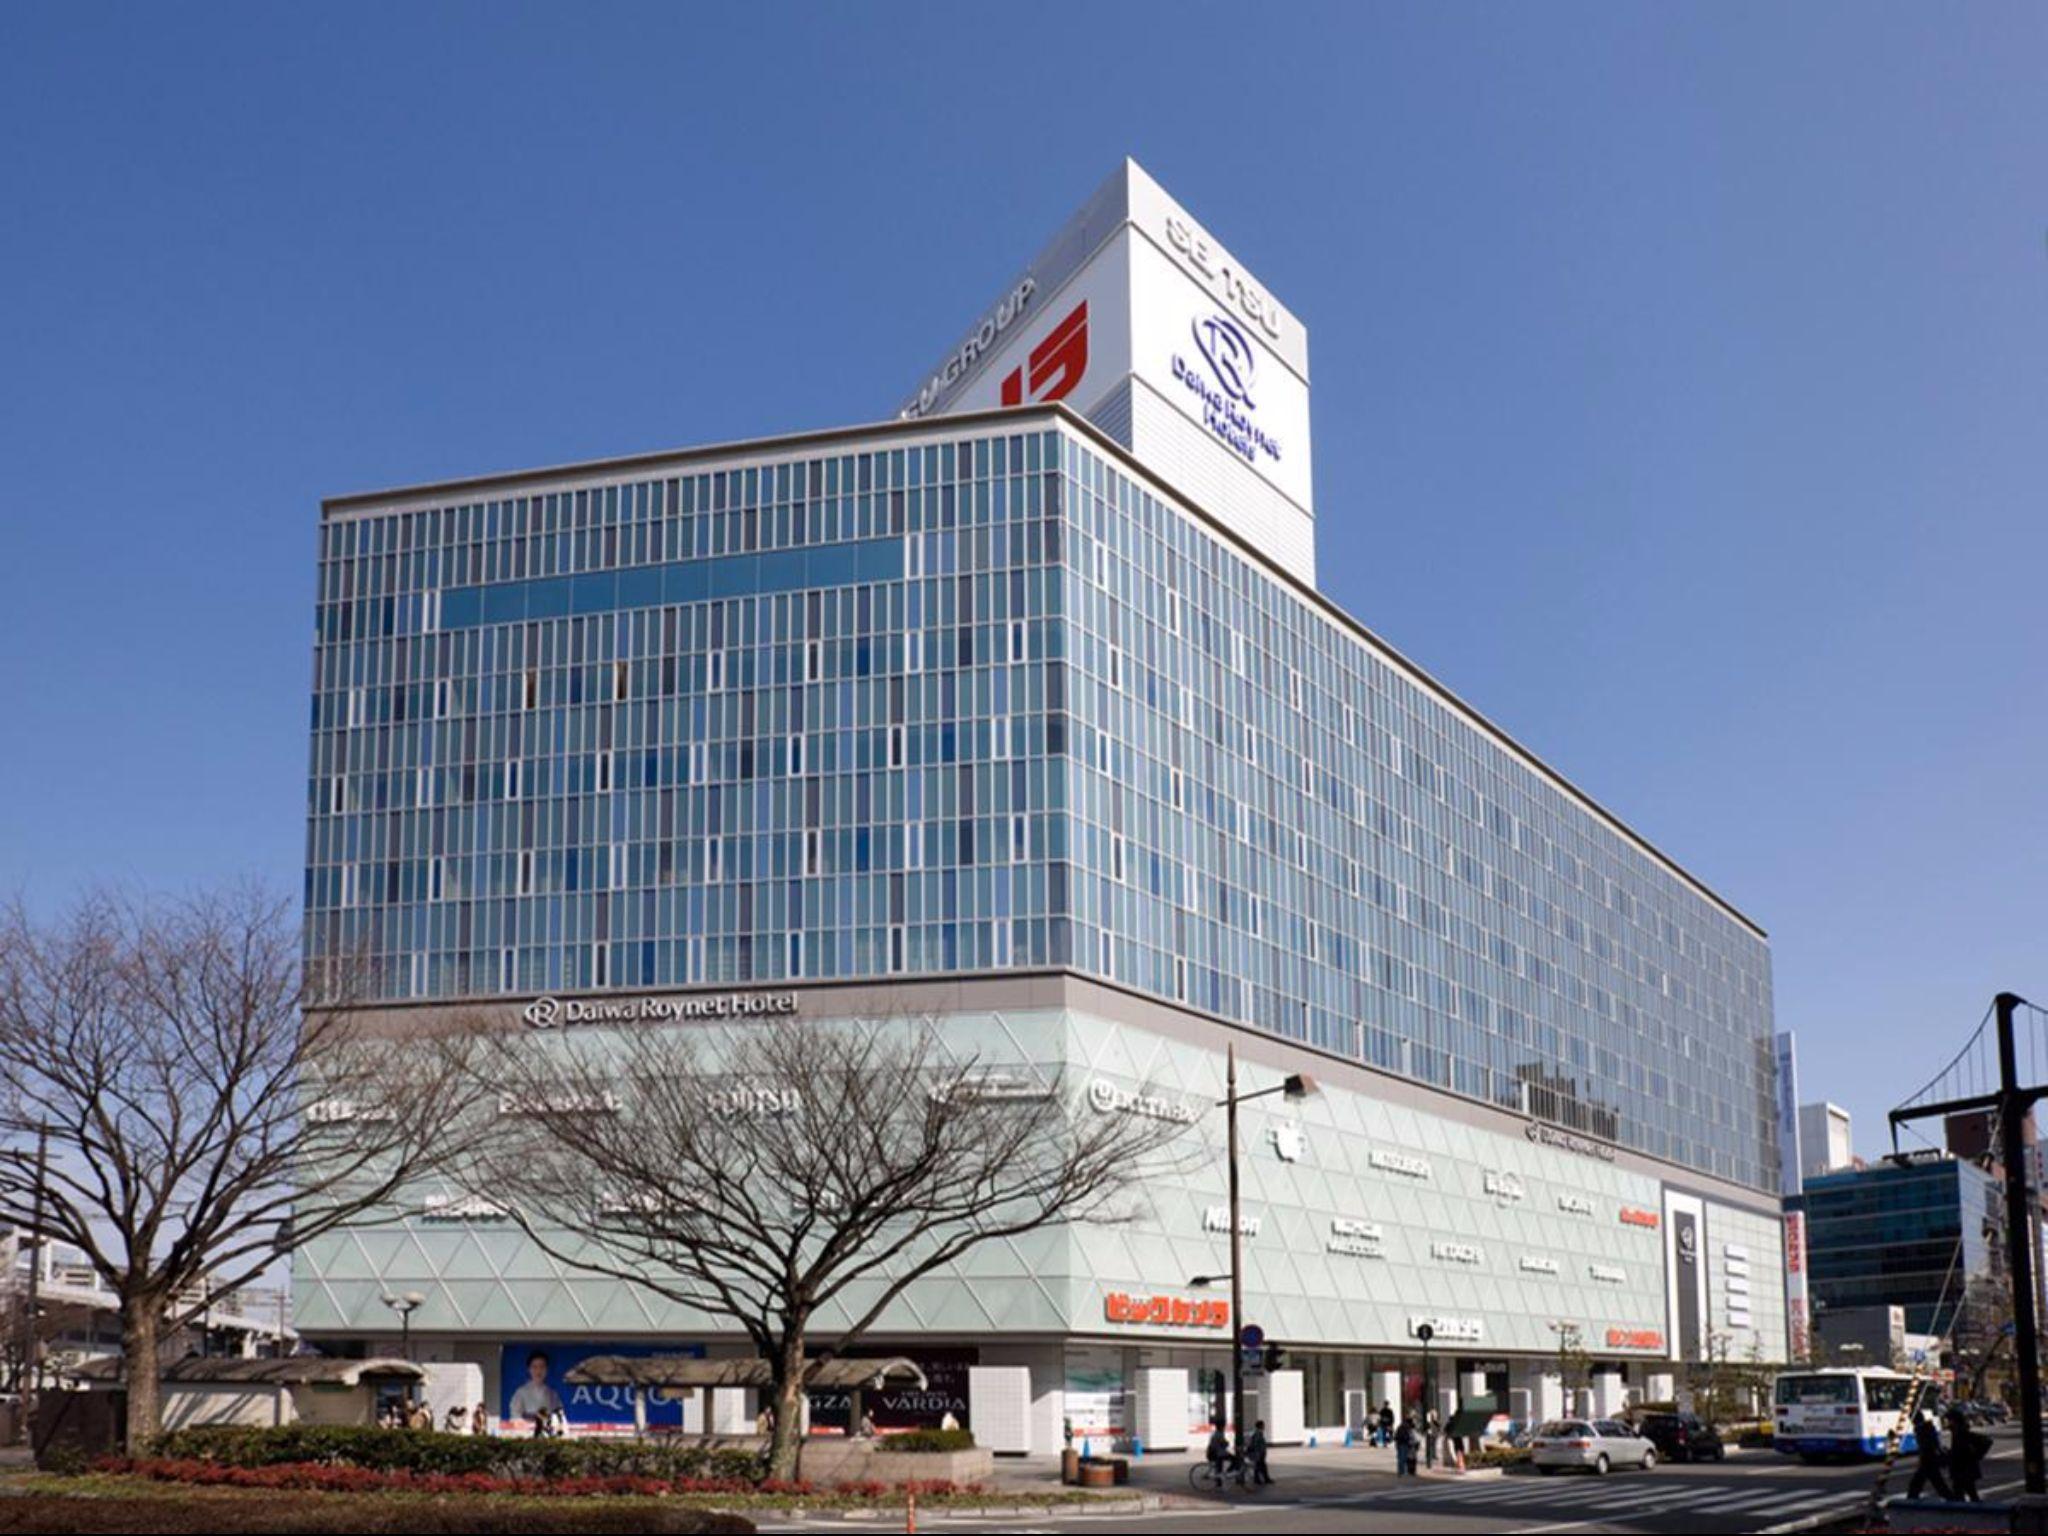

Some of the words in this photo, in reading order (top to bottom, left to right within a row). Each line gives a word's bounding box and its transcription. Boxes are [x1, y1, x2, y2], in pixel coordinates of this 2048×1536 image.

[944, 277, 1036, 386] GROUP
[566, 1001, 636, 1022] Daiwa
[640, 997, 727, 1021] Roynet
[732, 992, 798, 1014] Hotel
[572, 1384, 684, 1410] AQUO
[882, 1397, 967, 1411] VARDIA
